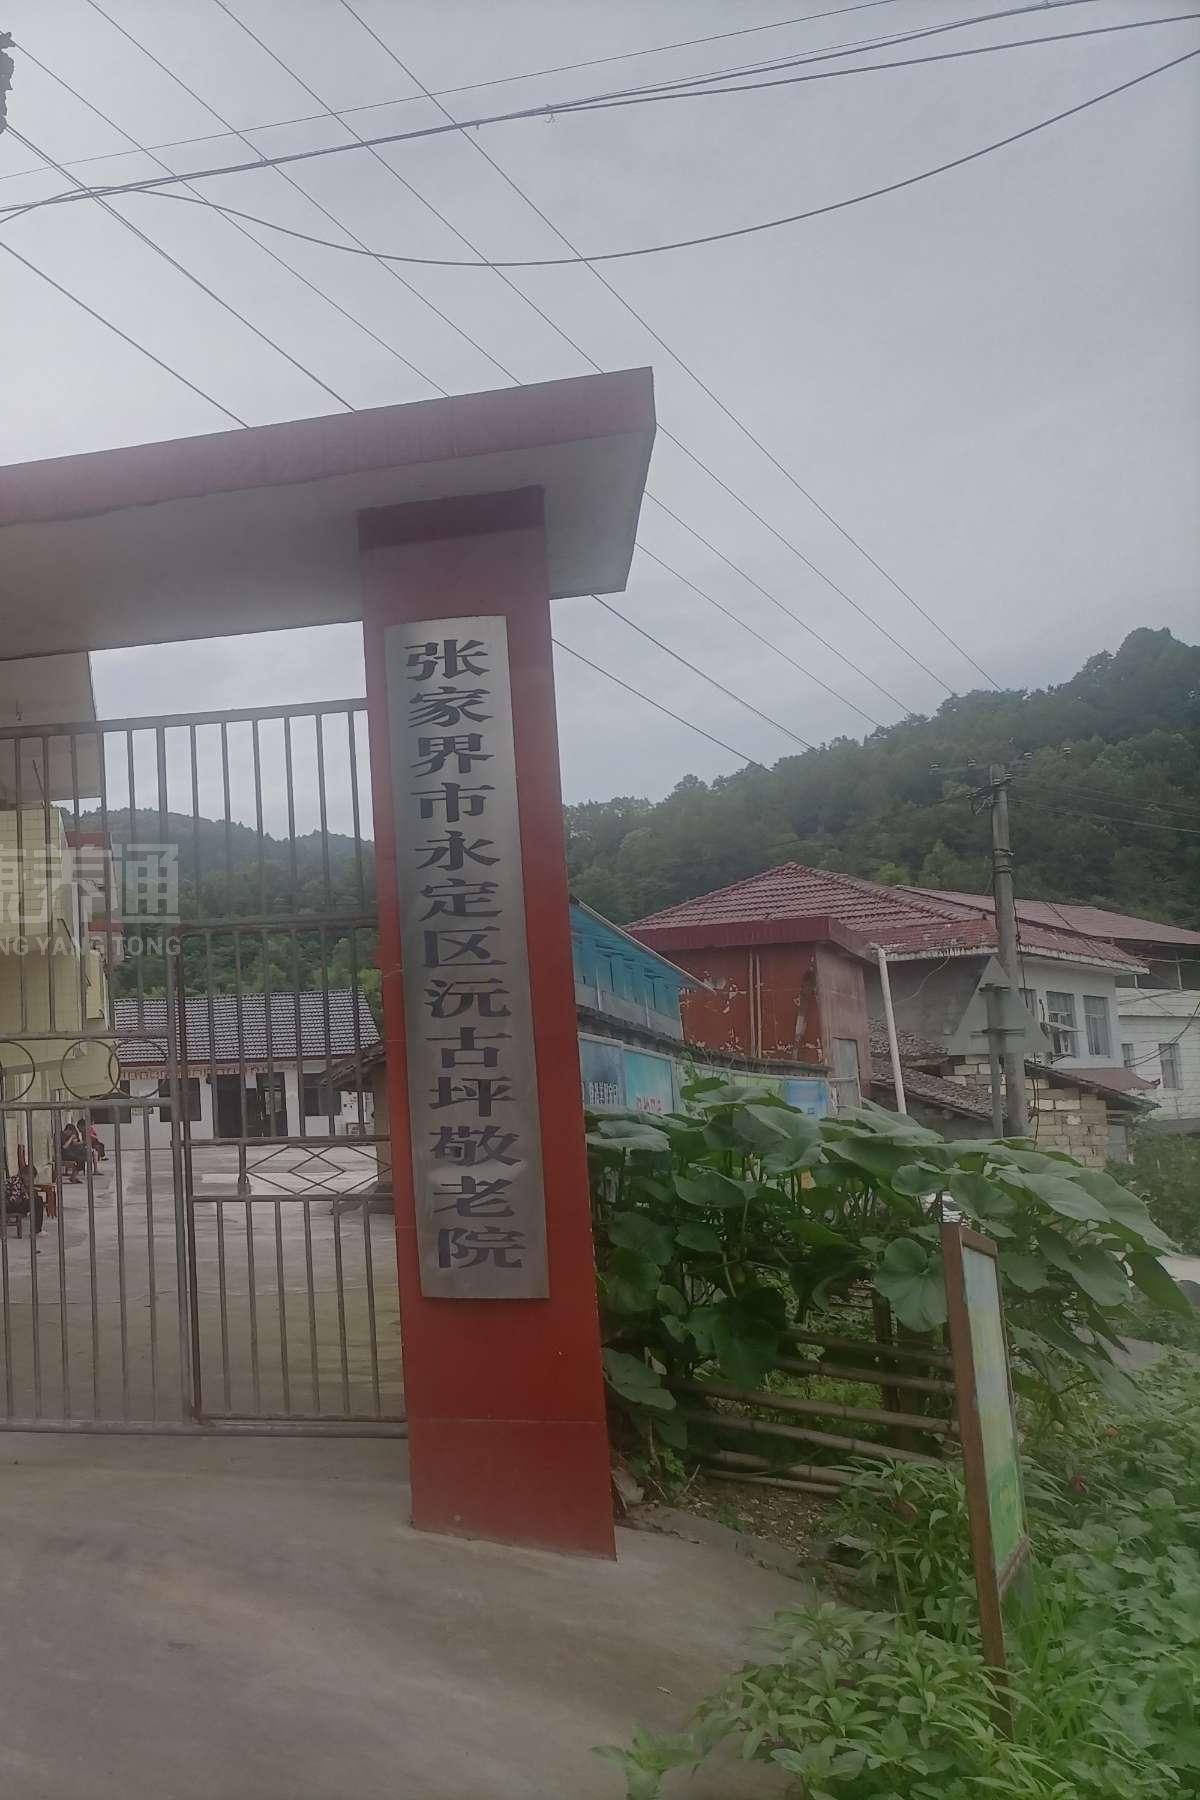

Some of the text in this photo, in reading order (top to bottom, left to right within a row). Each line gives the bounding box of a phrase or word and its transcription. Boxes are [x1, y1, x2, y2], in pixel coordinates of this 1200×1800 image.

[405, 638, 526, 1269] 张家界市永定区沅古坪敬老院
